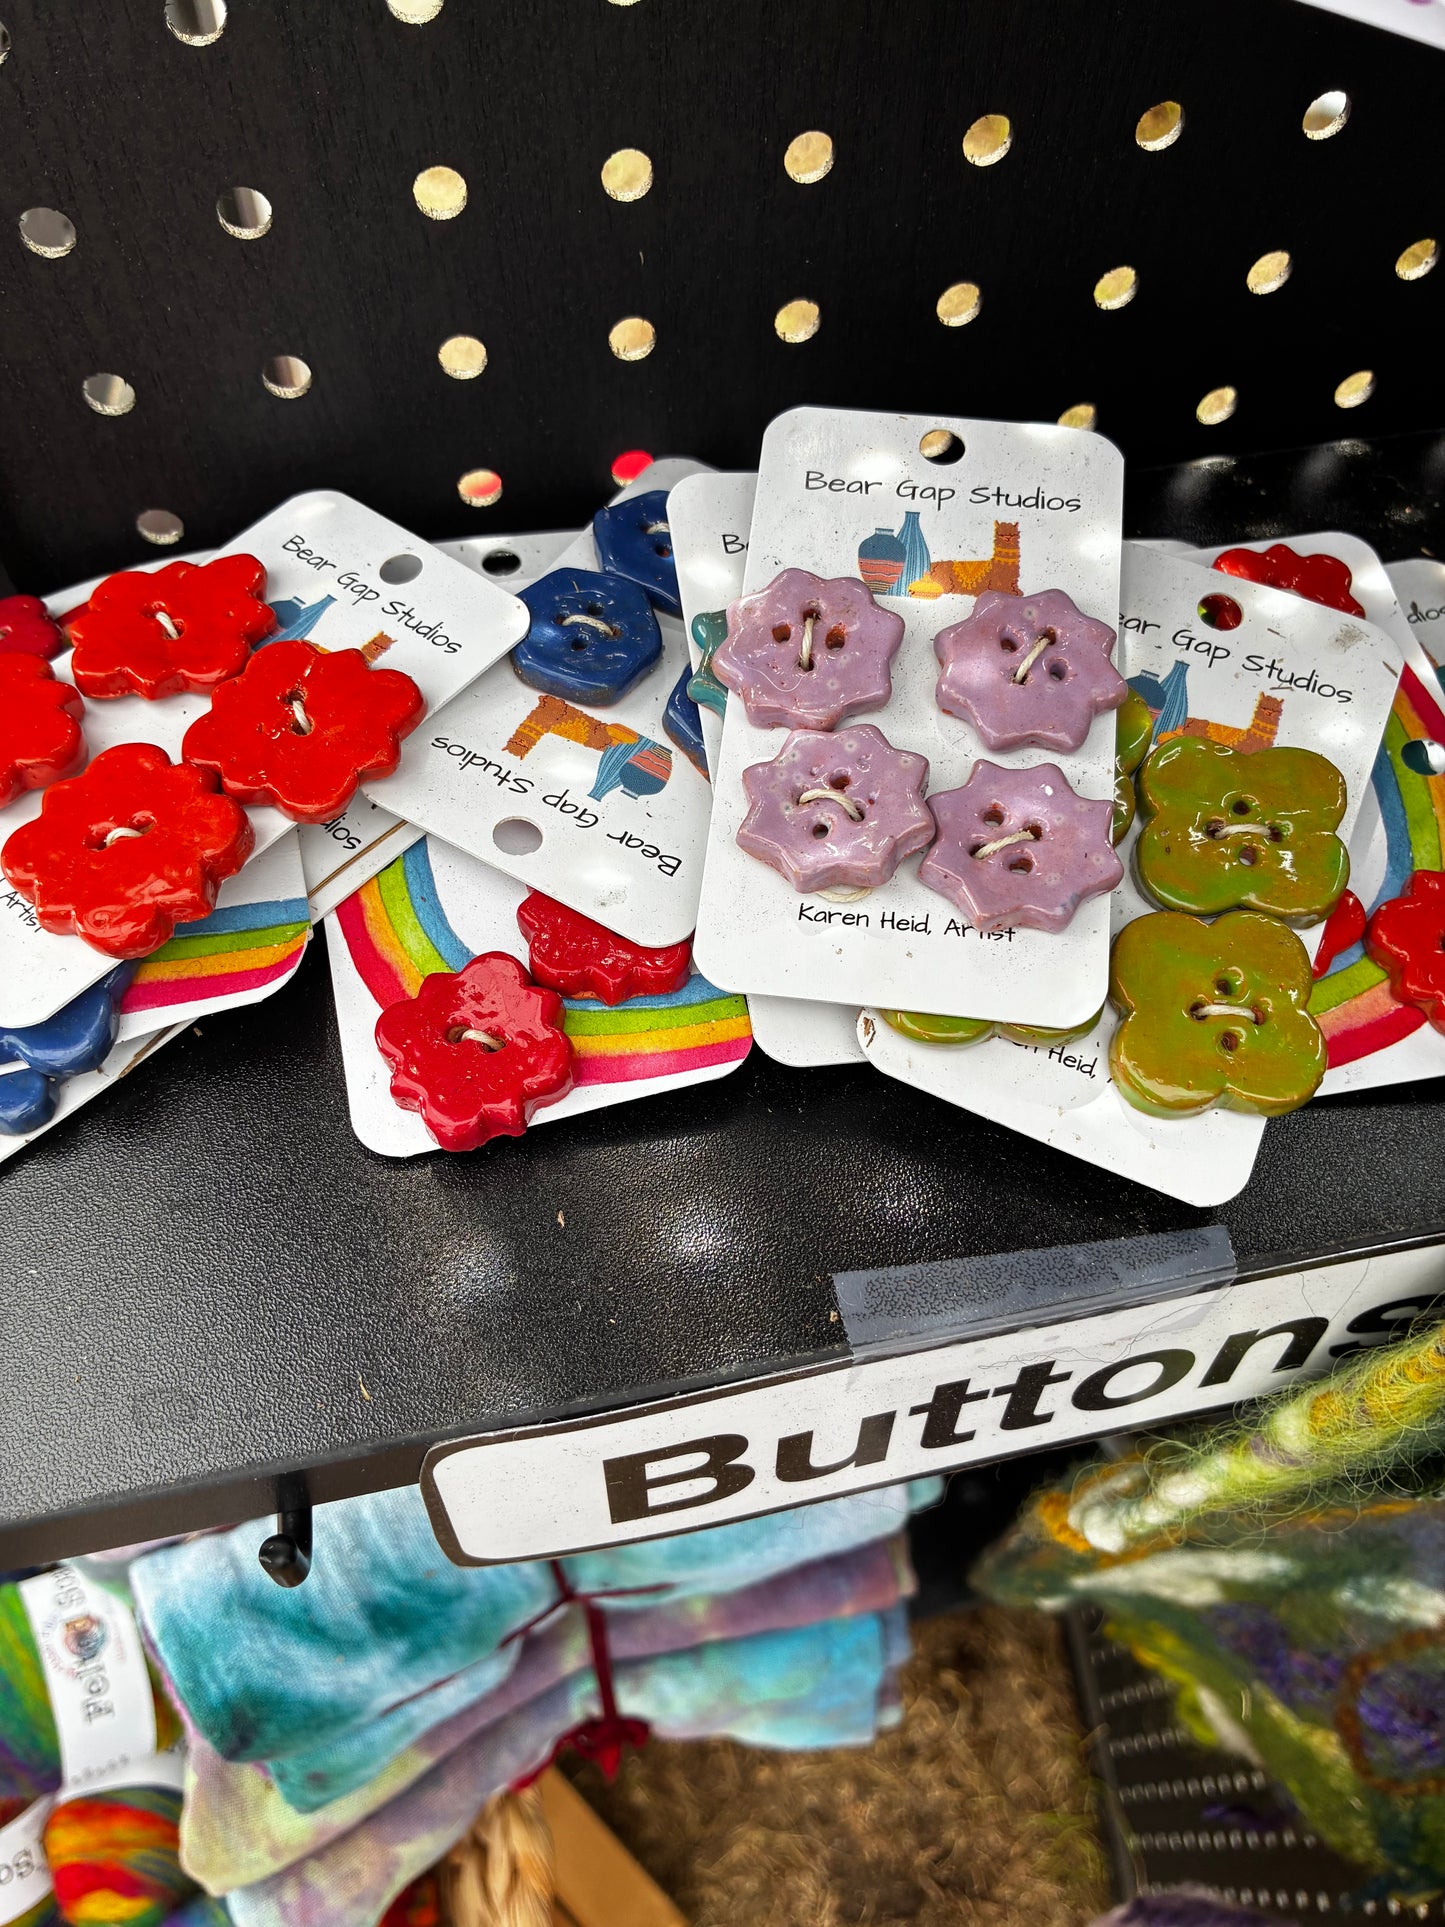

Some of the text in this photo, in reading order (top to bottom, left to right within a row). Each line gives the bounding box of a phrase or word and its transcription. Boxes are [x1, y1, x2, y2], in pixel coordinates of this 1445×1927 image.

[804, 470, 1082, 513] Bear Gap Studios
[282, 535, 462, 654] Bear Gap Studios
[1172, 629, 1231, 668] Gap
[1242, 655, 1353, 704] Studios
[431, 737, 683, 877] Bear Gap Studios
[798, 903, 869, 928] Karen
[880, 912, 932, 936] Heid,
[1048, 1046, 1098, 1079] Heid,
[602, 1294, 1445, 1524] Buttons
